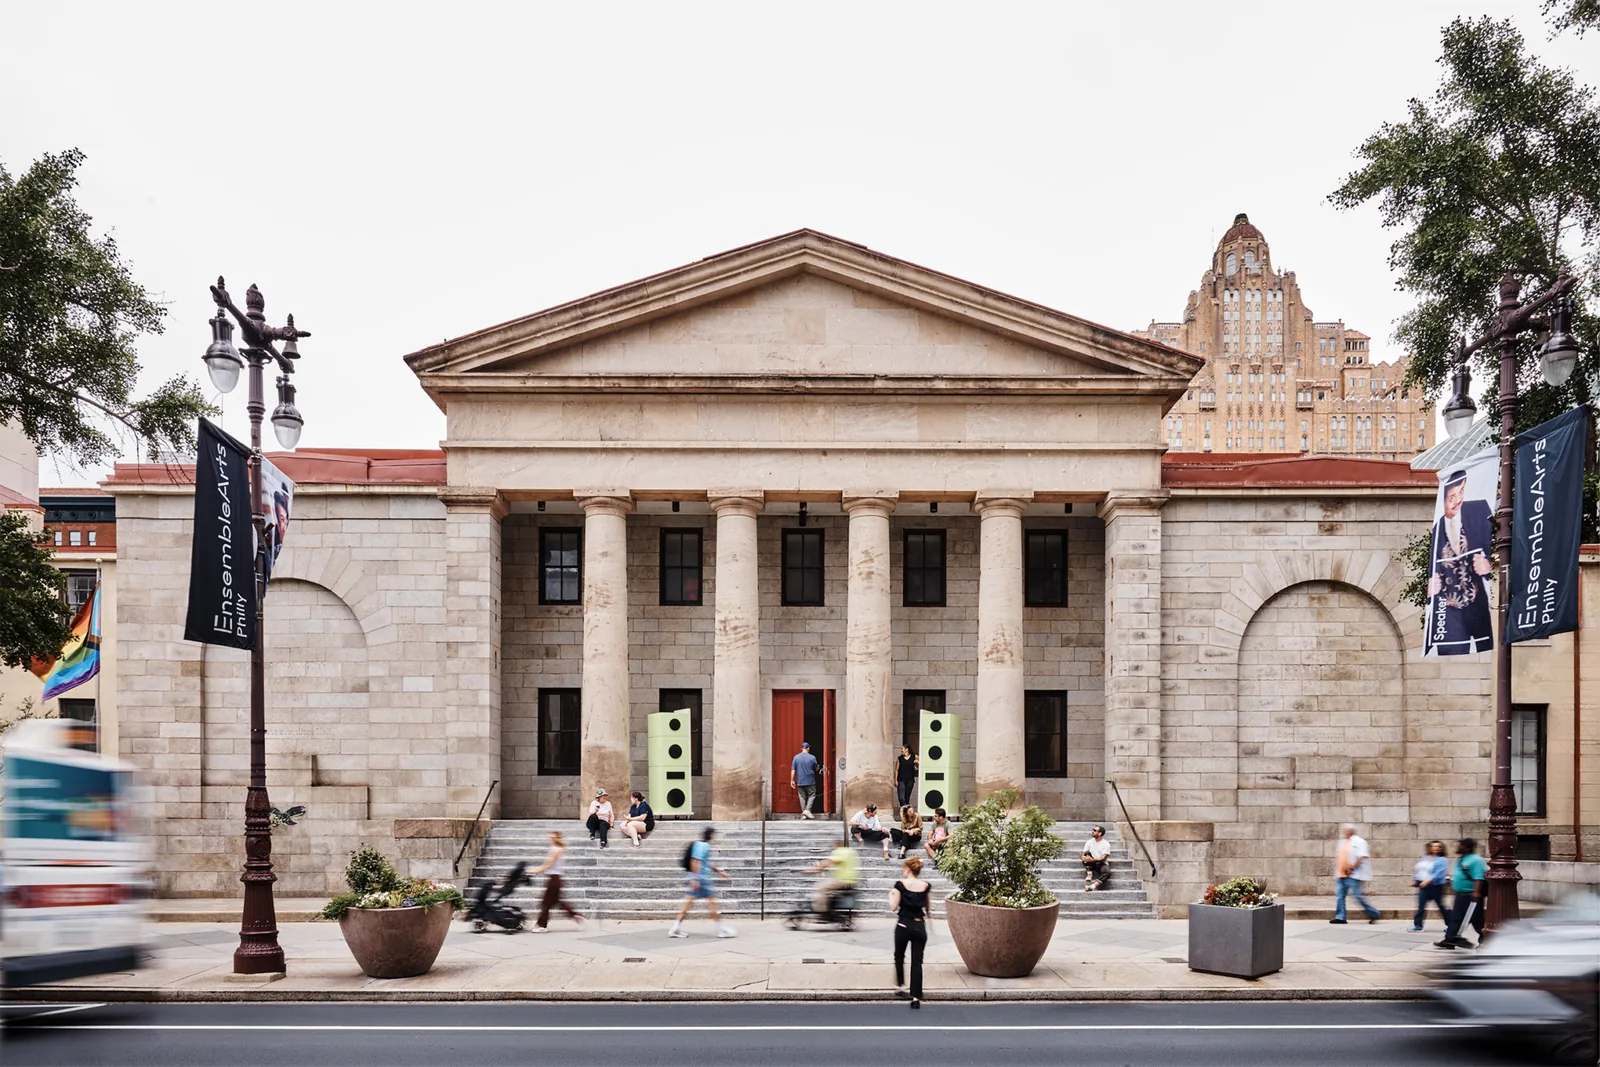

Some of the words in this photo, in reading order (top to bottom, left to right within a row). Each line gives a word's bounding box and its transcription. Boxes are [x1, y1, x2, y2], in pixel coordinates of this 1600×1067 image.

[236, 593, 248, 638] Philly
[1434, 596, 1447, 641] Speaker
[1541, 578, 1558, 625] Philly
